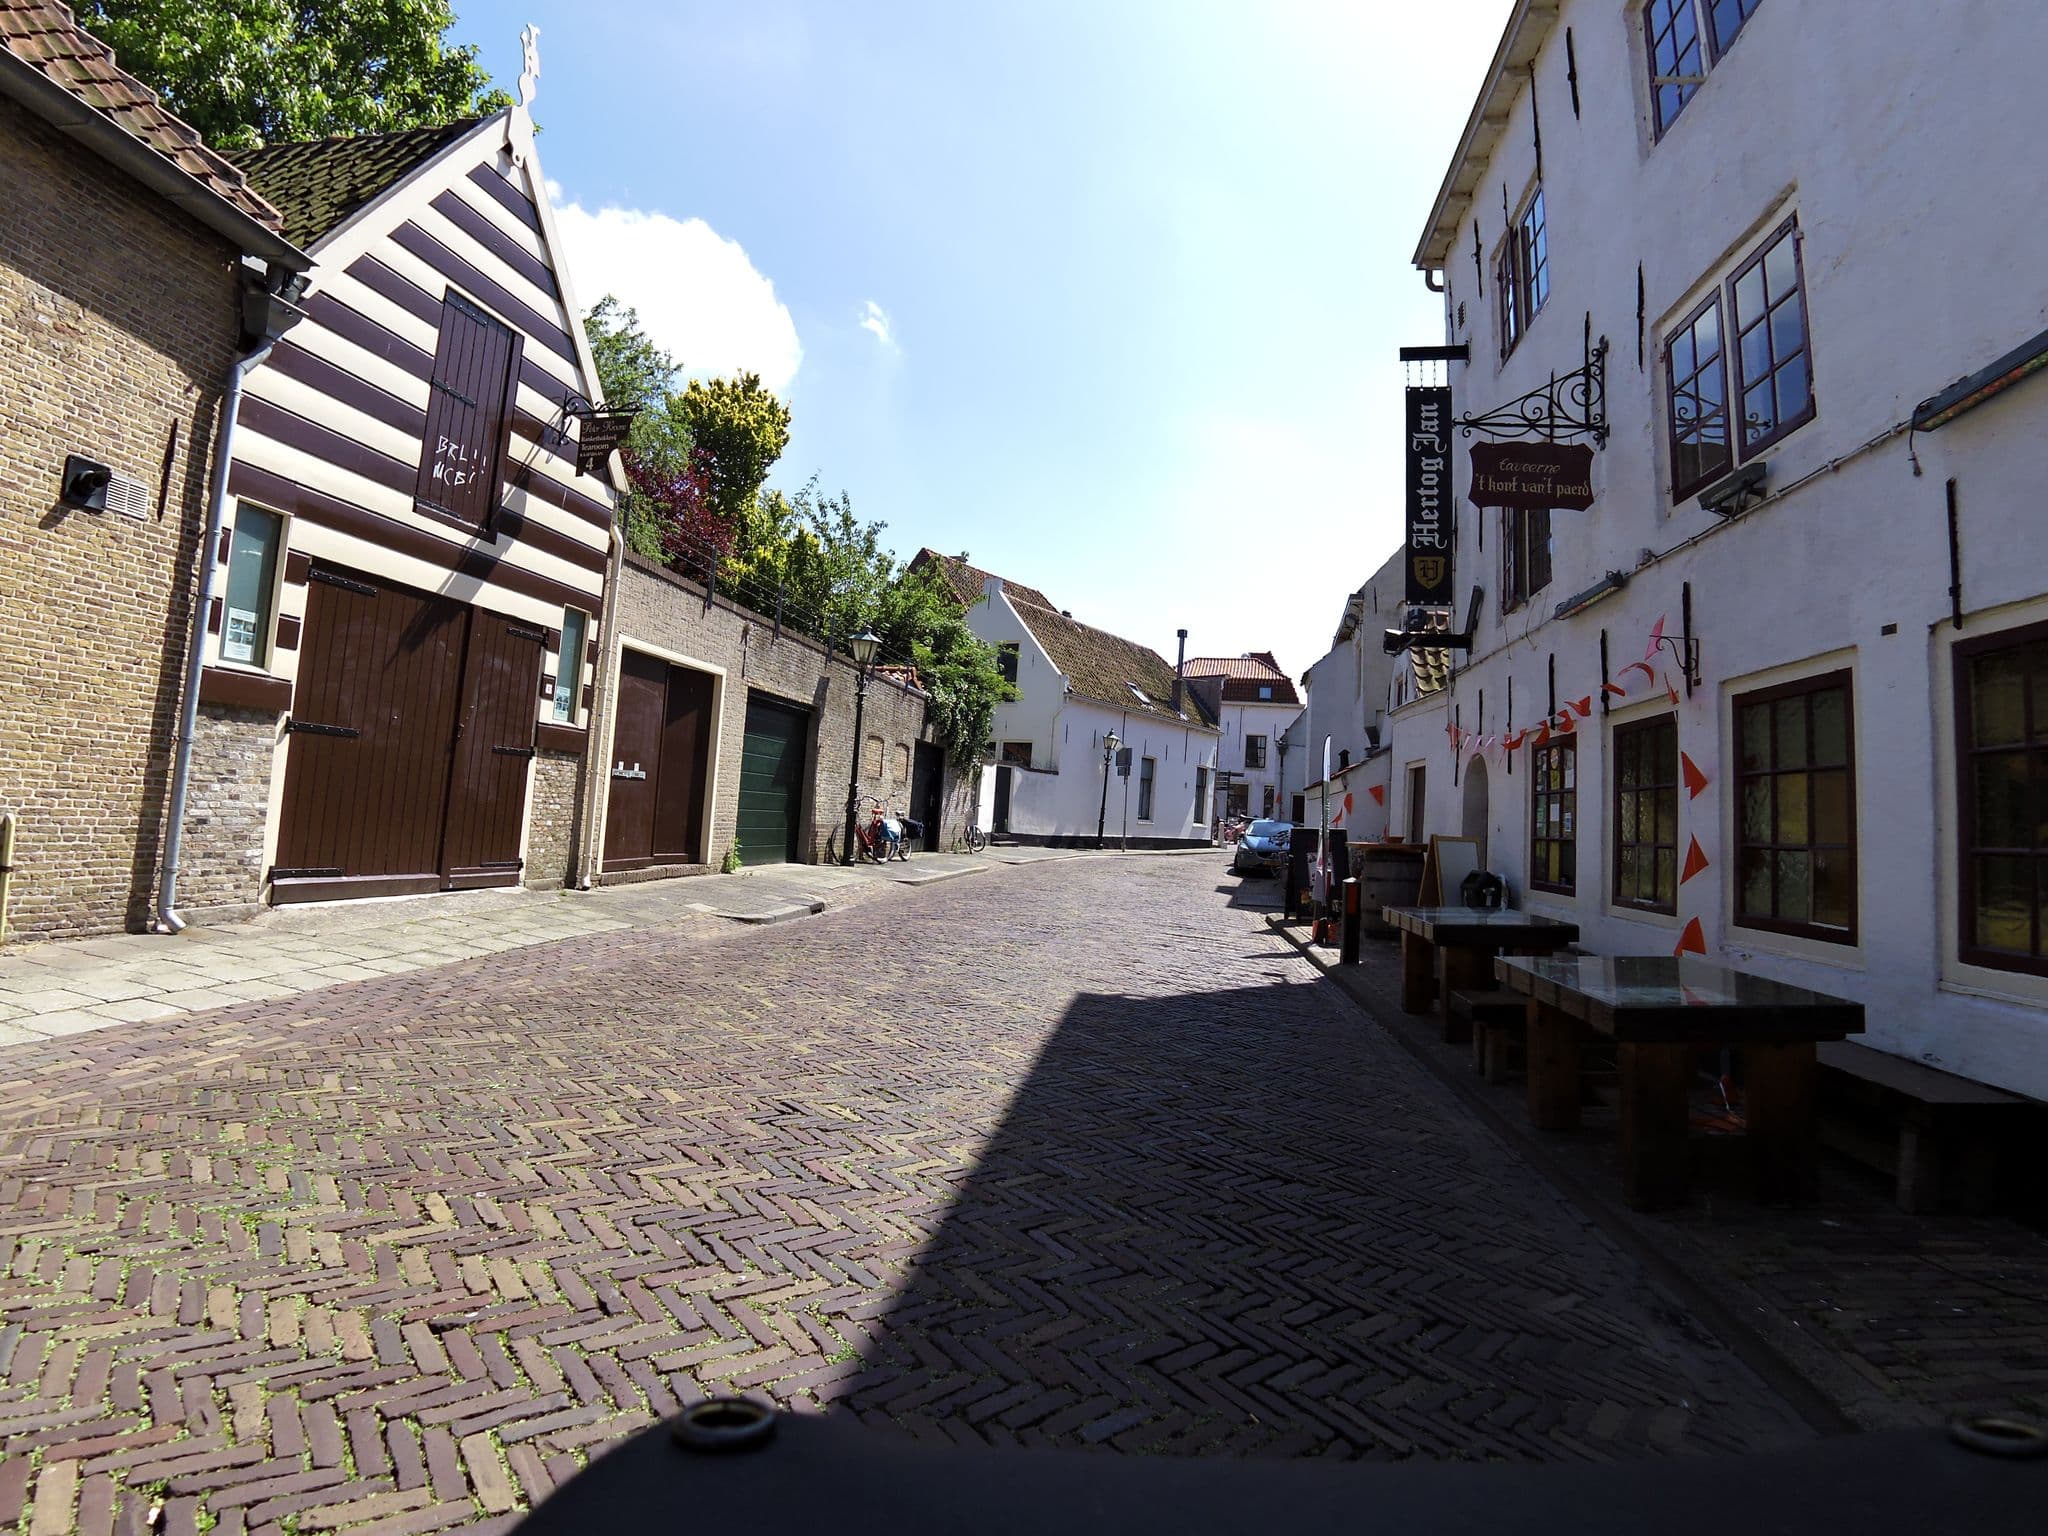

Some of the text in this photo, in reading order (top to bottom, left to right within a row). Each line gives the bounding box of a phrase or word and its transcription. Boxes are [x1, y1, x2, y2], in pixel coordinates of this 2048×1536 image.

[585, 457, 594, 470] 4
[1412, 402, 1448, 549] Hertog Jan
[1555, 480, 1590, 498] paerd
